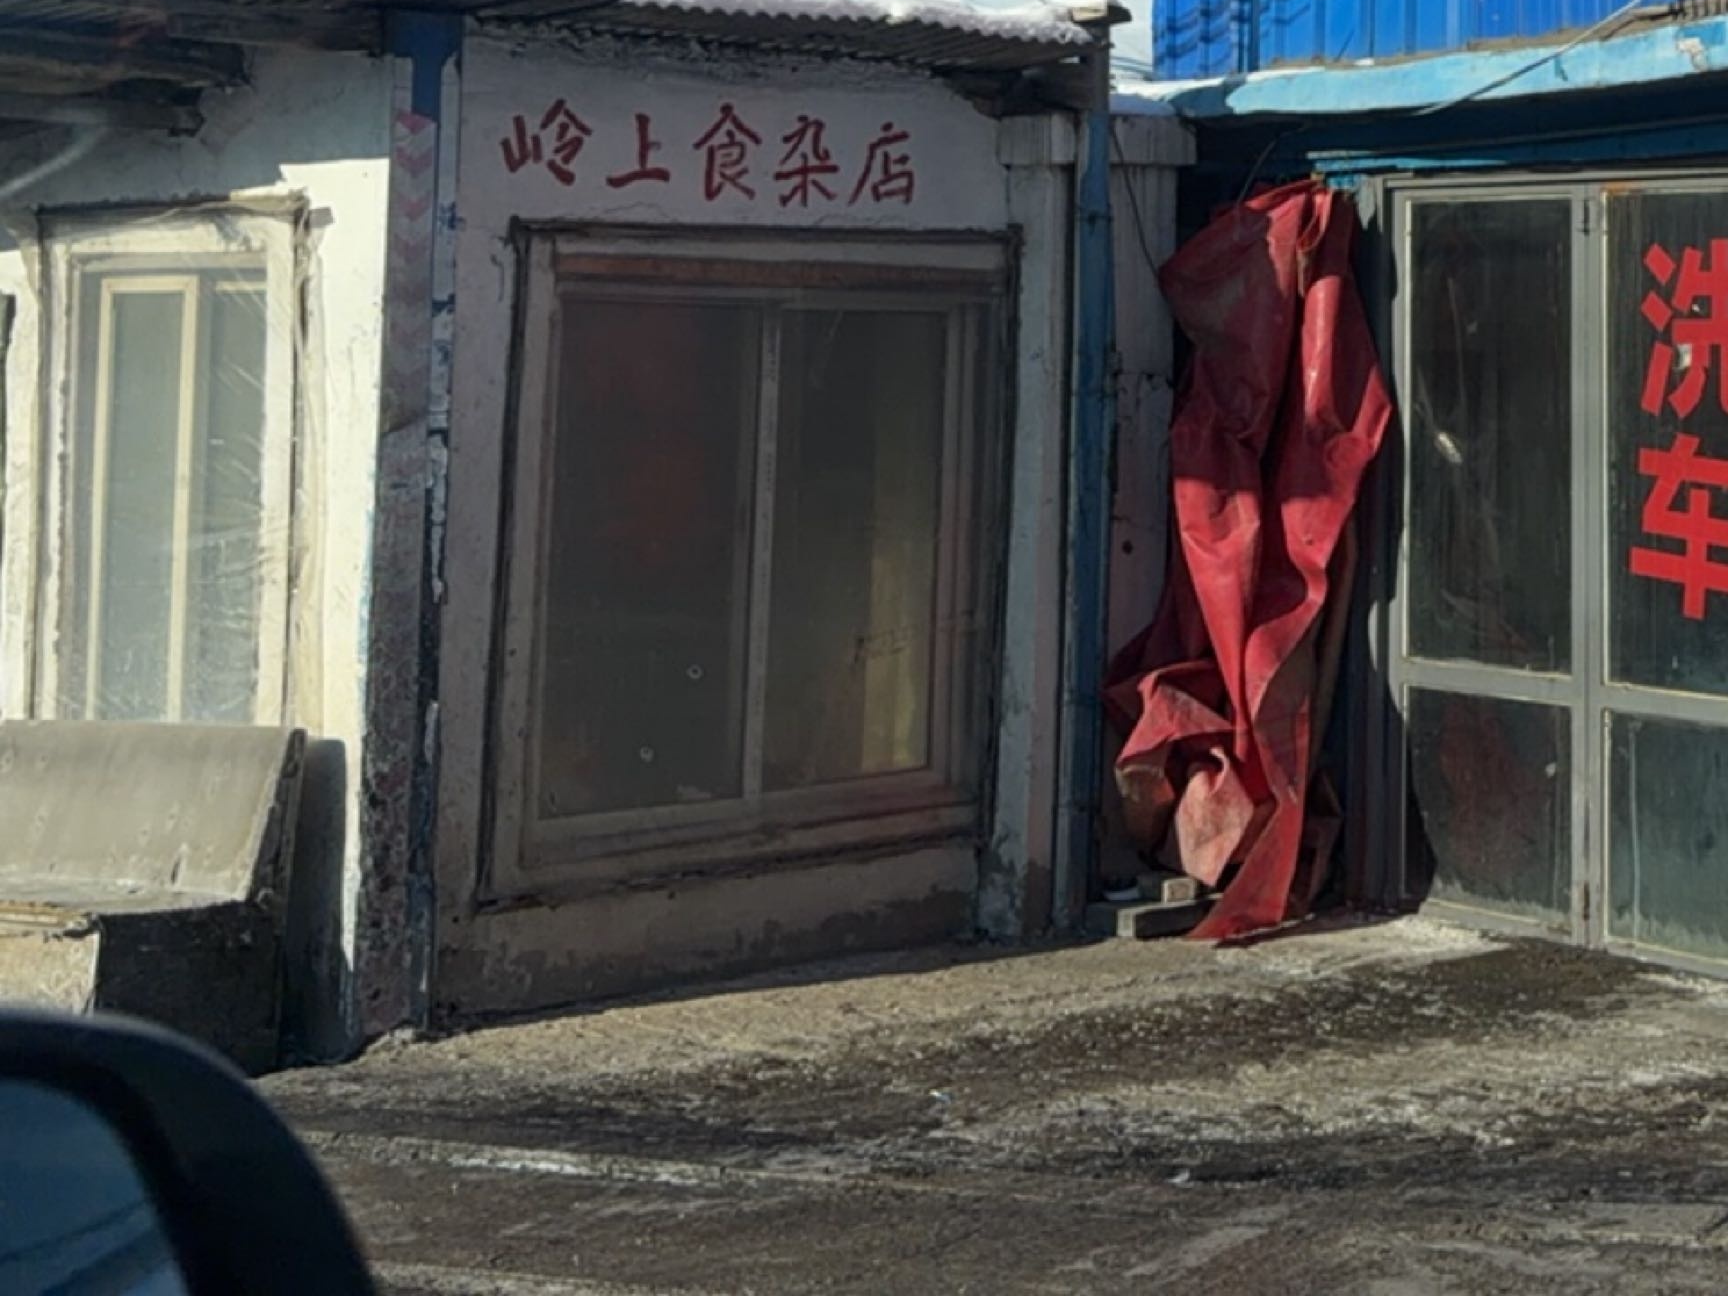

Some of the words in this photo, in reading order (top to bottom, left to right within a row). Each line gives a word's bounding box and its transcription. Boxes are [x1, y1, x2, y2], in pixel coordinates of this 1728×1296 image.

[500, 98, 916, 207] 岭上食杂店
